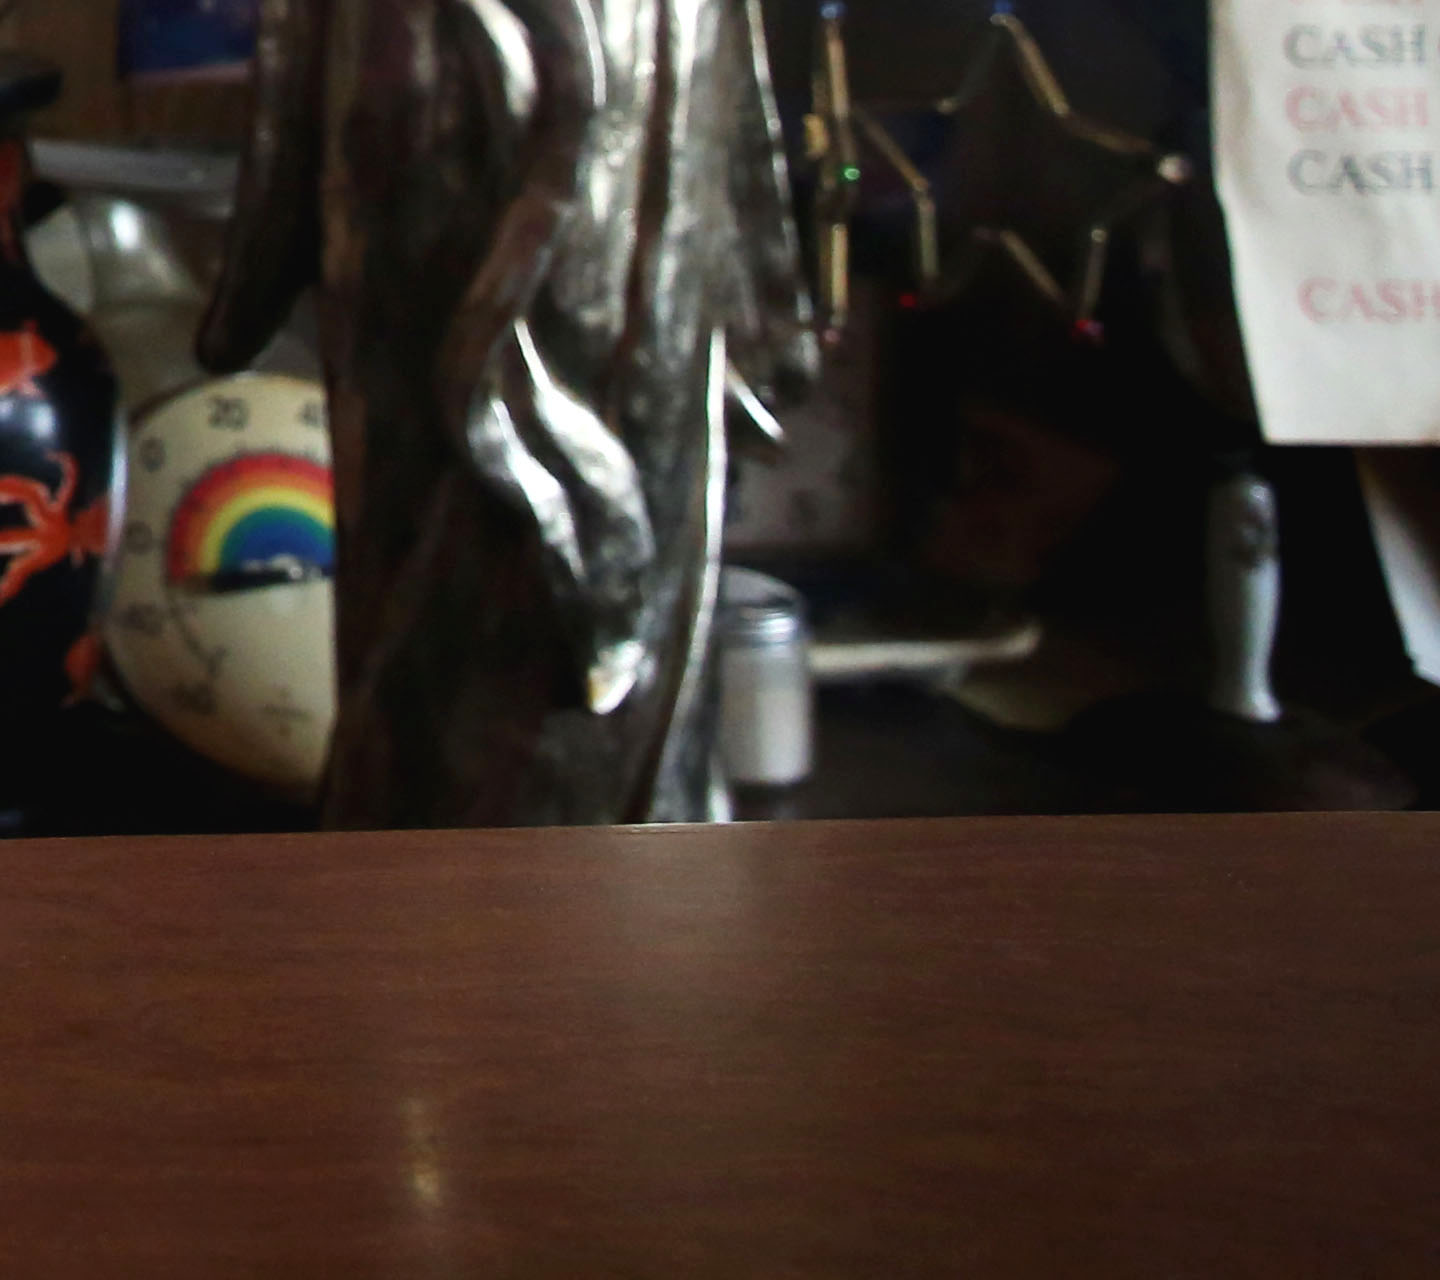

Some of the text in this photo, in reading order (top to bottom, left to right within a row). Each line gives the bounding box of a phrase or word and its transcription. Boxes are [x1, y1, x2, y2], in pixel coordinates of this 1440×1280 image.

[1282, 23, 1429, 70] CASH
[1285, 85, 1431, 133] CASH
[1286, 148, 1435, 197] CASH
[208, 396, 249, 431] 20
